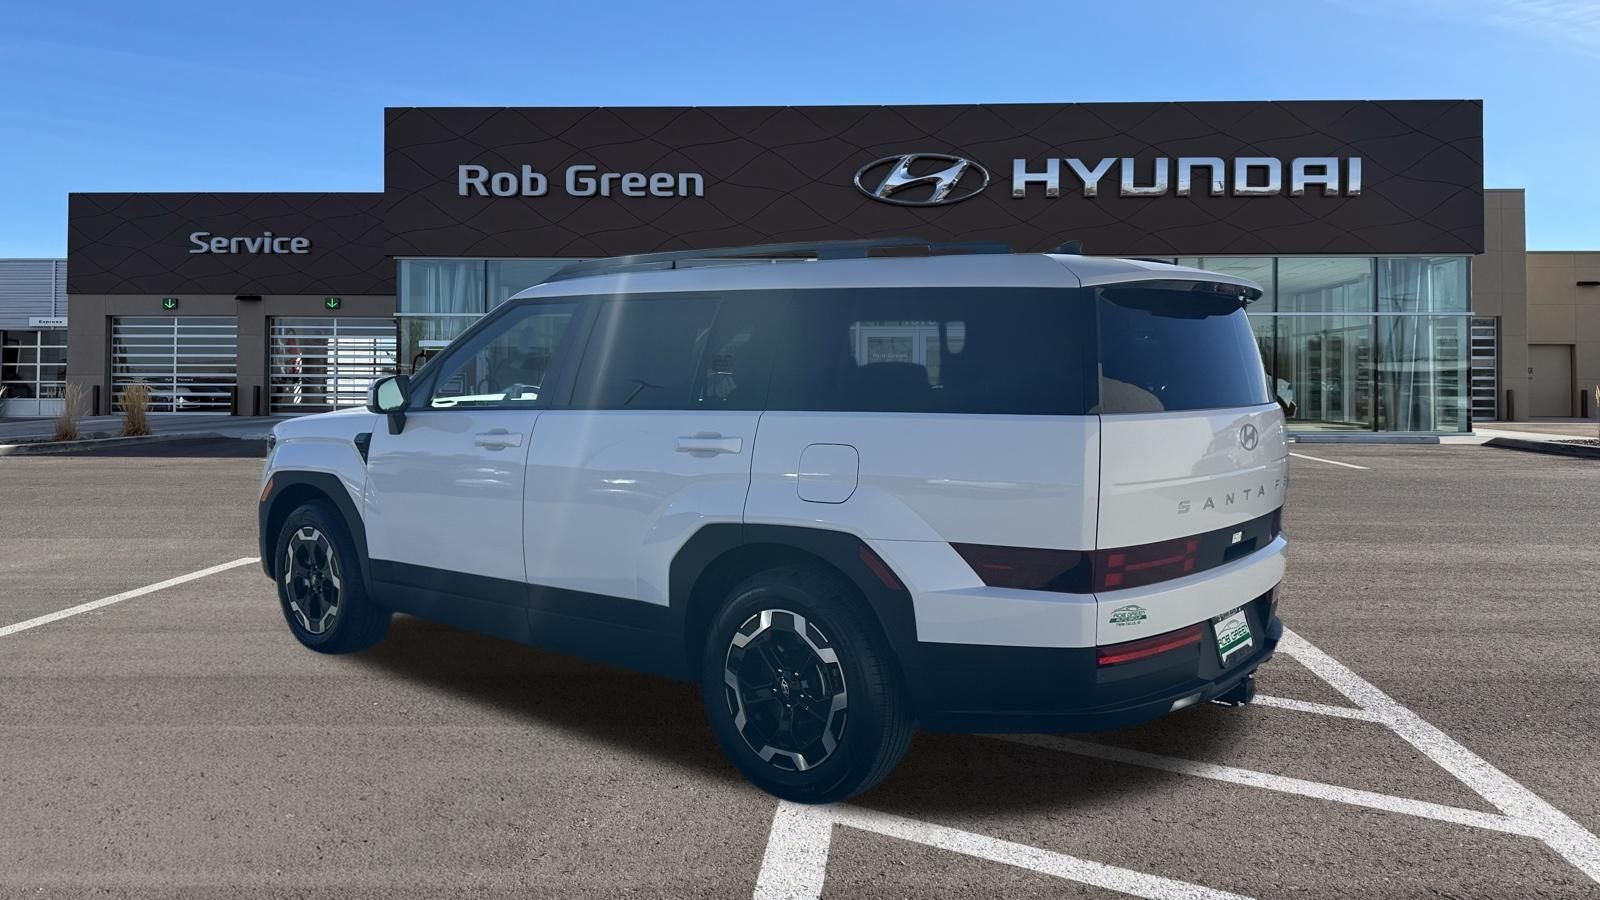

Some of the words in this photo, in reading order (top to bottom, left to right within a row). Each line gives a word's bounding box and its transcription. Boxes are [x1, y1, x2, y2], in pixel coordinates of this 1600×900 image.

[458, 164, 548, 197] Rob
[565, 164, 705, 197] Green
[1011, 156, 1361, 199] HYUNDAI
[189, 231, 311, 255] Service
[1176, 484, 1265, 514] SANTA
